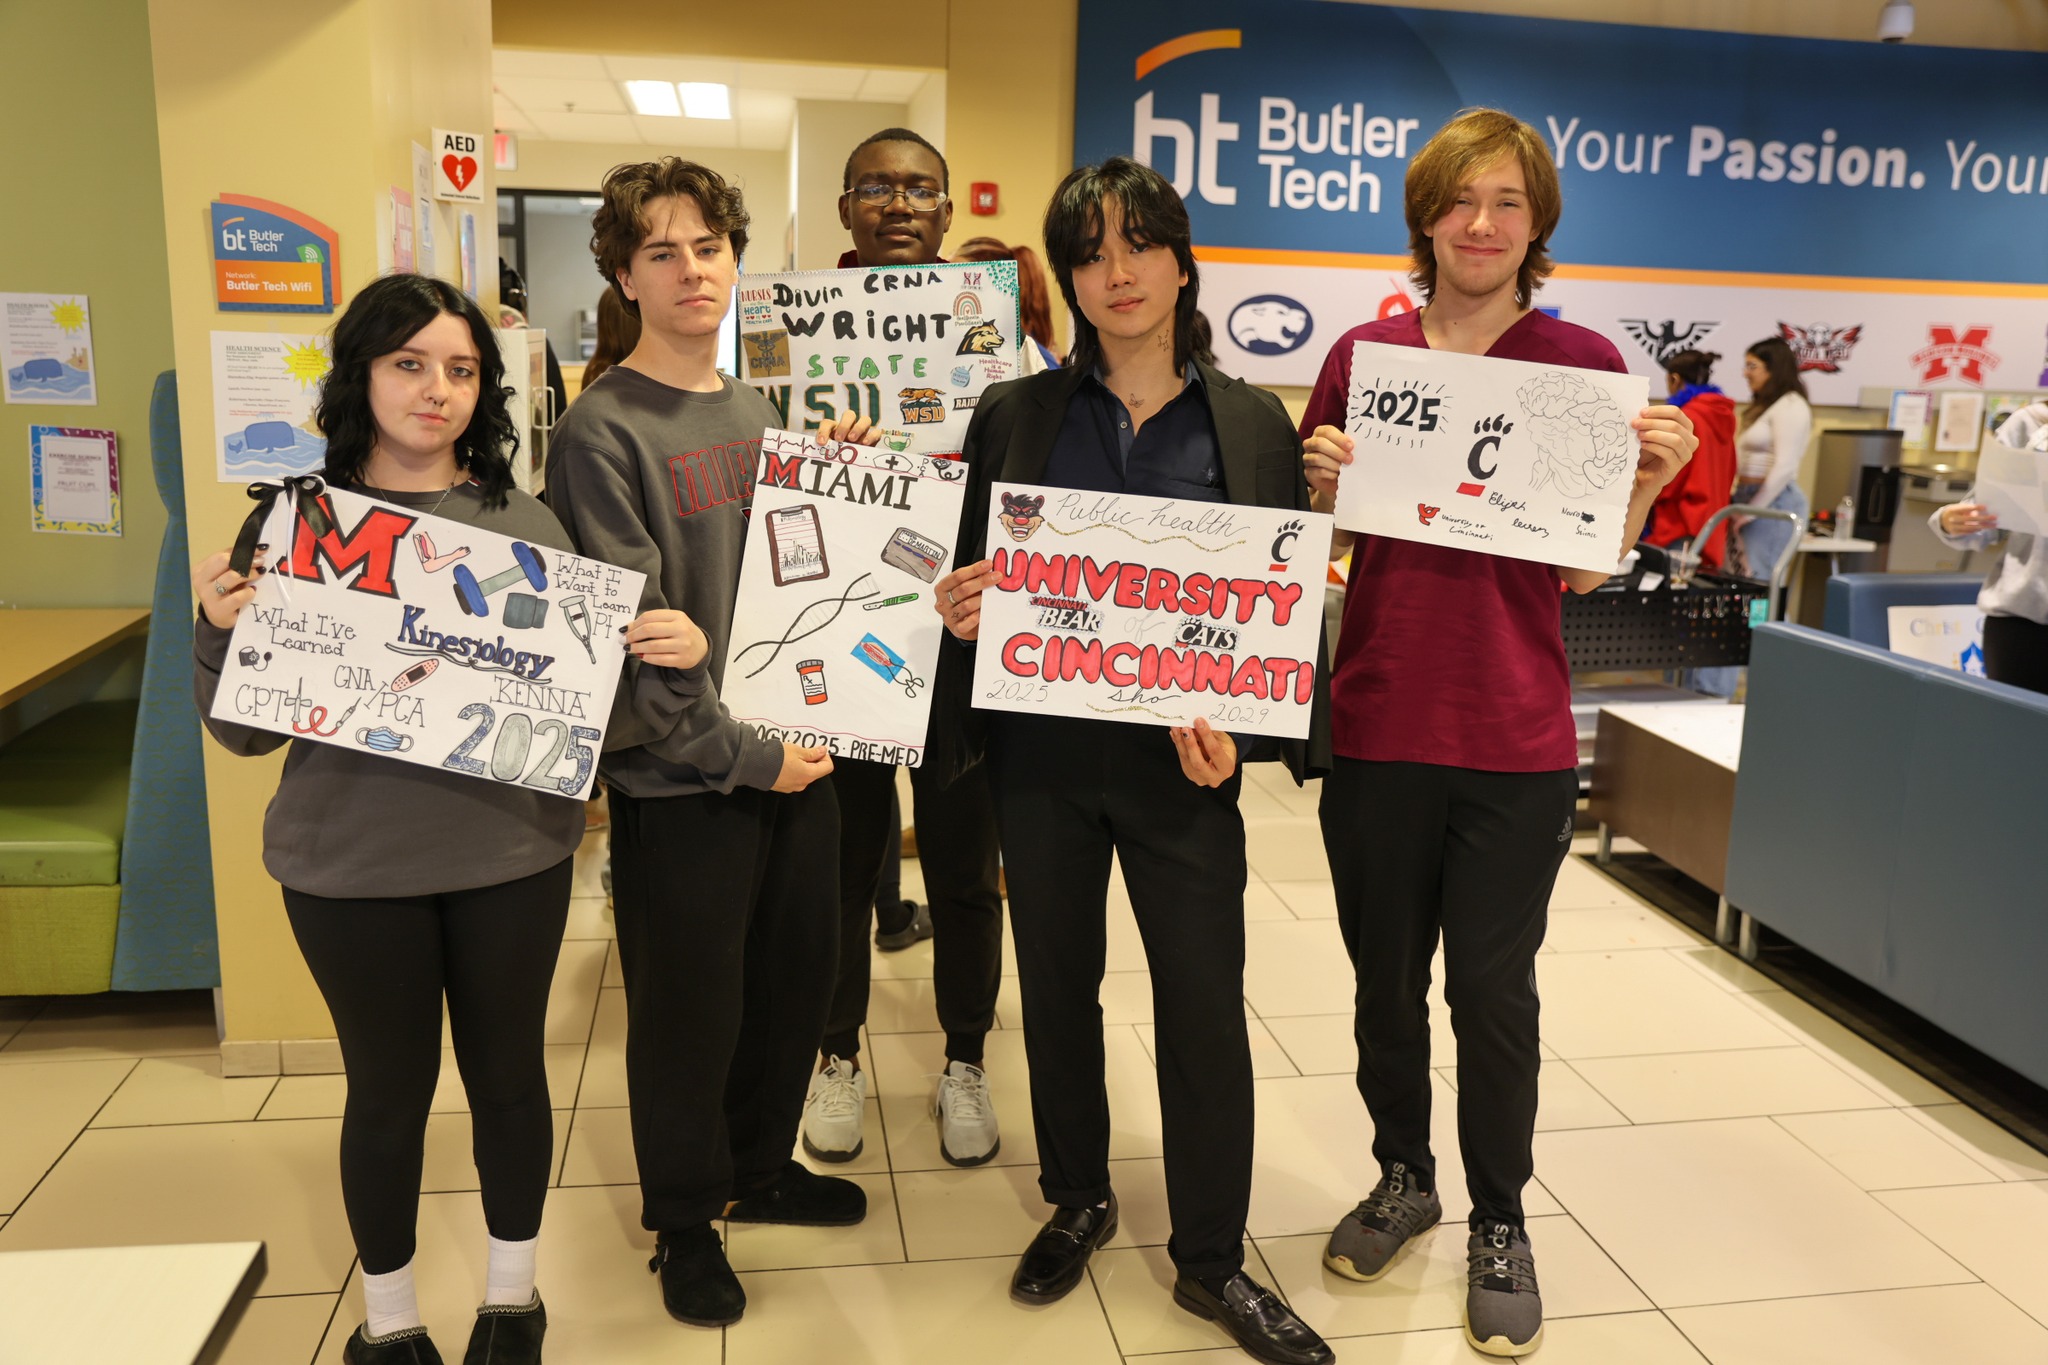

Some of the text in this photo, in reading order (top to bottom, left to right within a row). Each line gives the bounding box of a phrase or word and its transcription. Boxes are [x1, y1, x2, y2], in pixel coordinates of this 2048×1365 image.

[1258, 96, 1420, 159] Butler
[444, 134, 476, 153] AED
[1546, 115, 1673, 174] Your
[1687, 125, 1926, 189] Passion.
[1257, 154, 1381, 214] Tech
[222, 228, 247, 251] bt
[249, 229, 284, 242] Butler
[250, 241, 278, 253] Tech
[226, 280, 312, 293] Butler Tech Wifi
[863, 271, 943, 295] CRNA
[744, 306, 771, 315] Heart
[806, 354, 929, 379] STATE
[904, 406, 946, 424] WSU
[1361, 390, 1441, 431] 2025
[757, 449, 919, 511] MIAMI
[1057, 492, 1250, 537] Public health
[1561, 507, 1580, 518] Neuro
[268, 493, 420, 600] M
[555, 553, 602, 579] What
[553, 572, 618, 596] Want to
[992, 547, 1303, 627] UNIVERSITY
[590, 594, 631, 614] Learn
[1030, 597, 1088, 610] CINCINNATI
[250, 603, 357, 640] What I've
[1040, 608, 1101, 632] BEAR
[1123, 609, 1166, 643] of
[270, 626, 345, 657] Learned
[398, 604, 556, 679] Kinesiology
[1175, 623, 1237, 649] CATS
[1001, 632, 1314, 705] CINCINNATI
[235, 674, 290, 722] CPT
[490, 677, 592, 721] KENNA
[986, 680, 1049, 702] 2025
[1208, 703, 1269, 725] 2029
[443, 703, 601, 797] 2025
